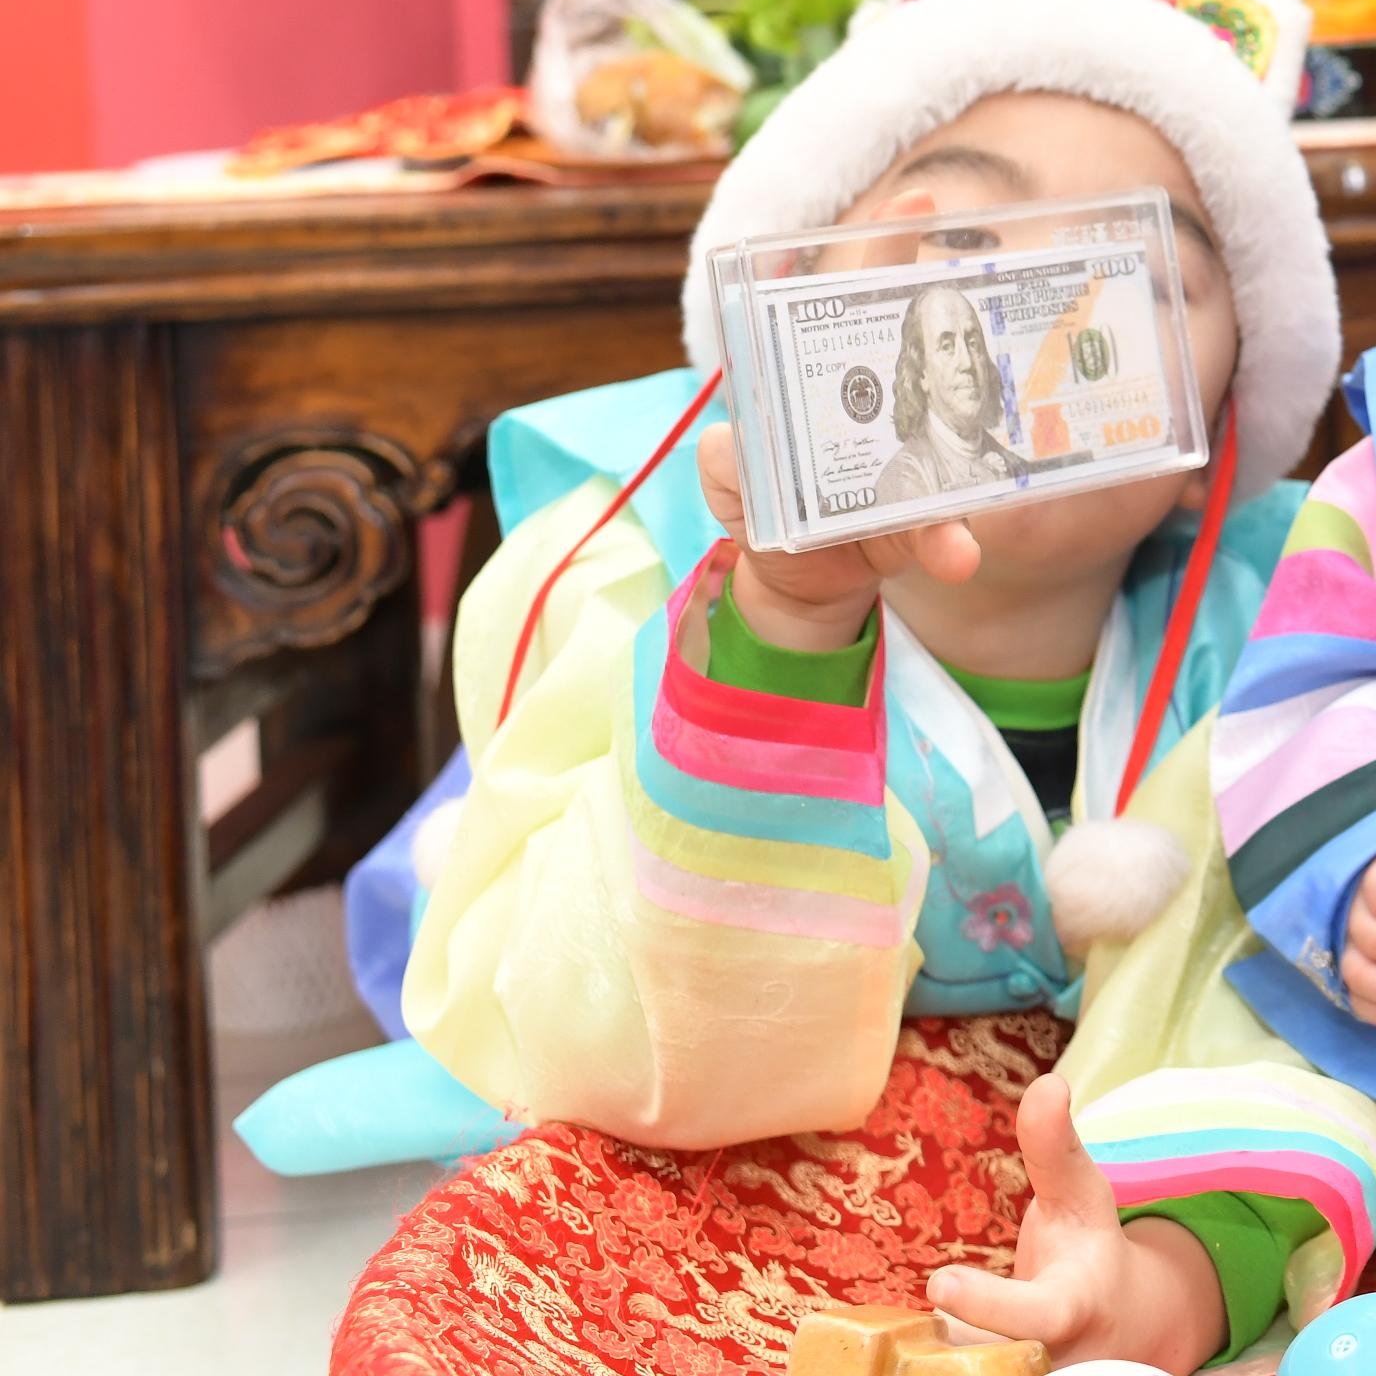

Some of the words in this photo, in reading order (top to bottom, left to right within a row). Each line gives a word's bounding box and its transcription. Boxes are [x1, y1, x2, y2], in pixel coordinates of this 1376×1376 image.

[1022, 264, 1070, 278] HUNDRED
[1090, 256, 1137, 280] 100
[796, 297, 846, 323] 100
[801, 323, 830, 334] MOTION
[832, 319, 863, 330] PICTURE
[866, 313, 900, 324] PURPOSES
[801, 327, 896, 356] LL91146514A
[1103, 414, 1162, 447] 100
[826, 487, 877, 513] 100
